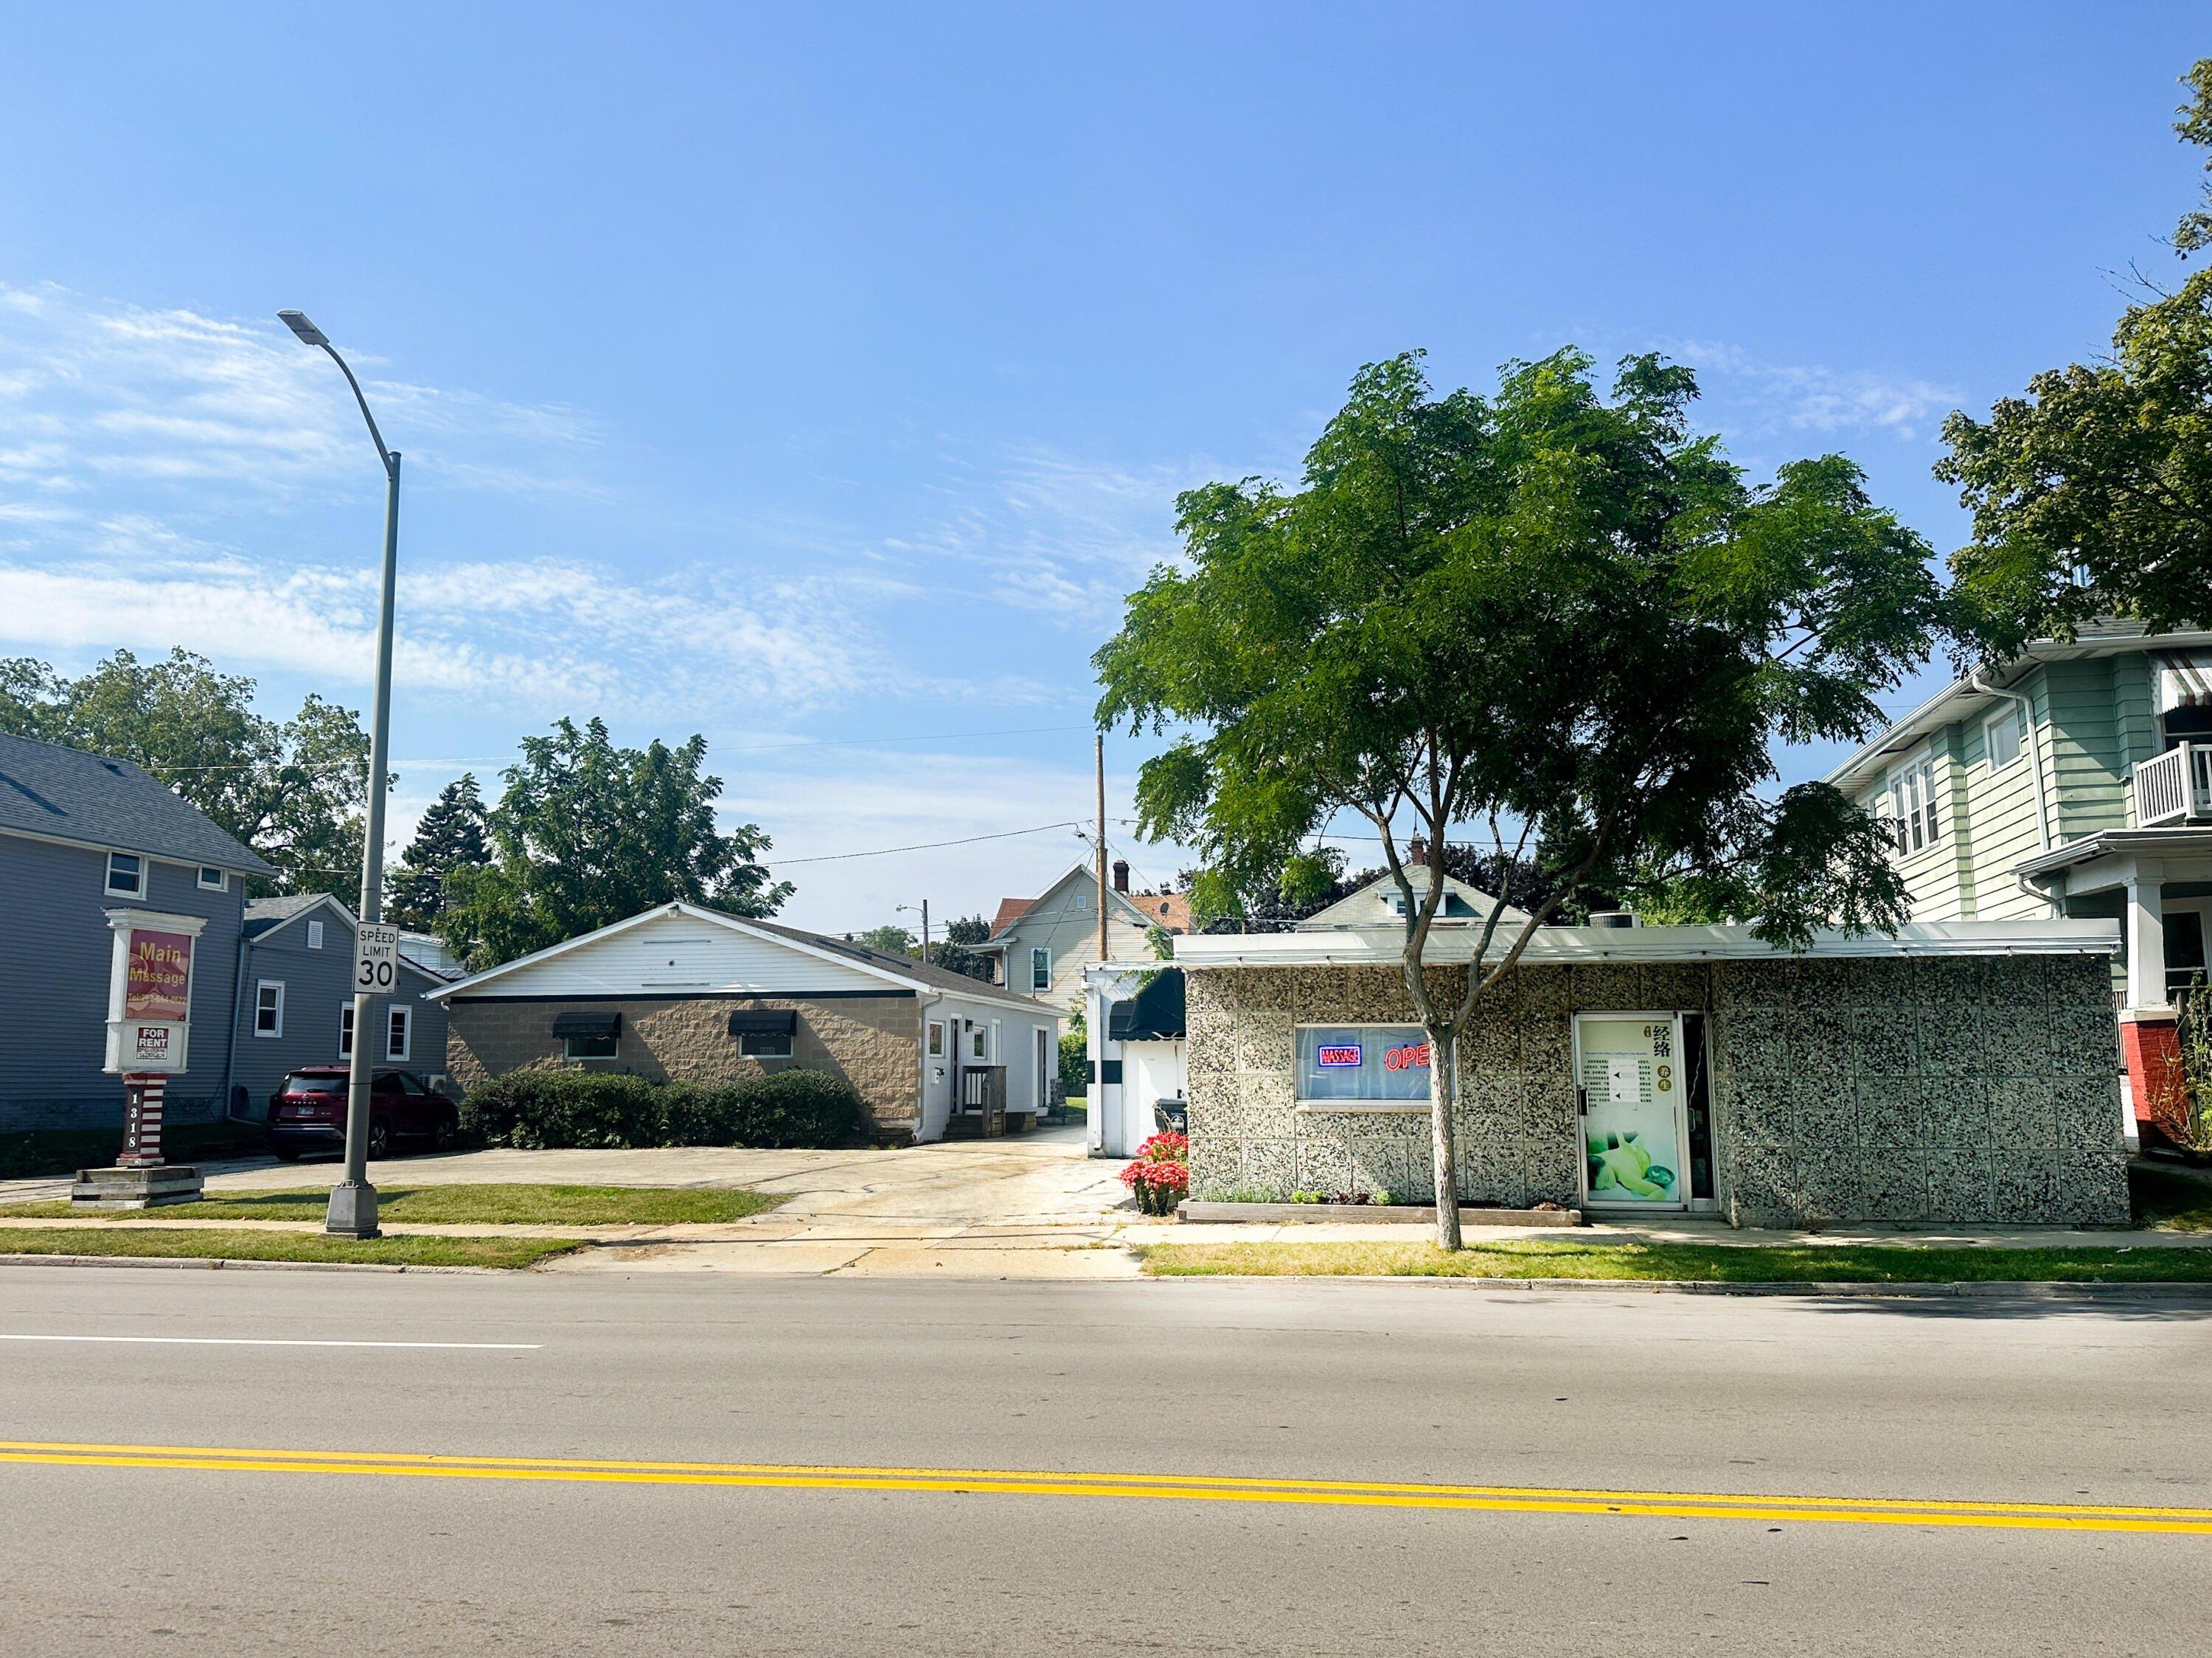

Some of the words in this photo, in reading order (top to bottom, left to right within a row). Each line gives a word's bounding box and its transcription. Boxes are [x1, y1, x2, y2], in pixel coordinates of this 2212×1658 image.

[360, 930, 395, 944] SPEED
[140, 941, 181, 963] Main
[363, 945, 391, 957] LIMIT
[129, 966, 186, 988] Massage
[358, 960, 393, 986] 30
[139, 1037, 167, 1047] RENT
[142, 1028, 164, 1038] FOR
[1653, 1025, 1671, 1057] 经络
[1322, 1049, 1358, 1063] MASSAGE
[1385, 1044, 1430, 1071] OPE
[128, 1093, 138, 1148] 1318
